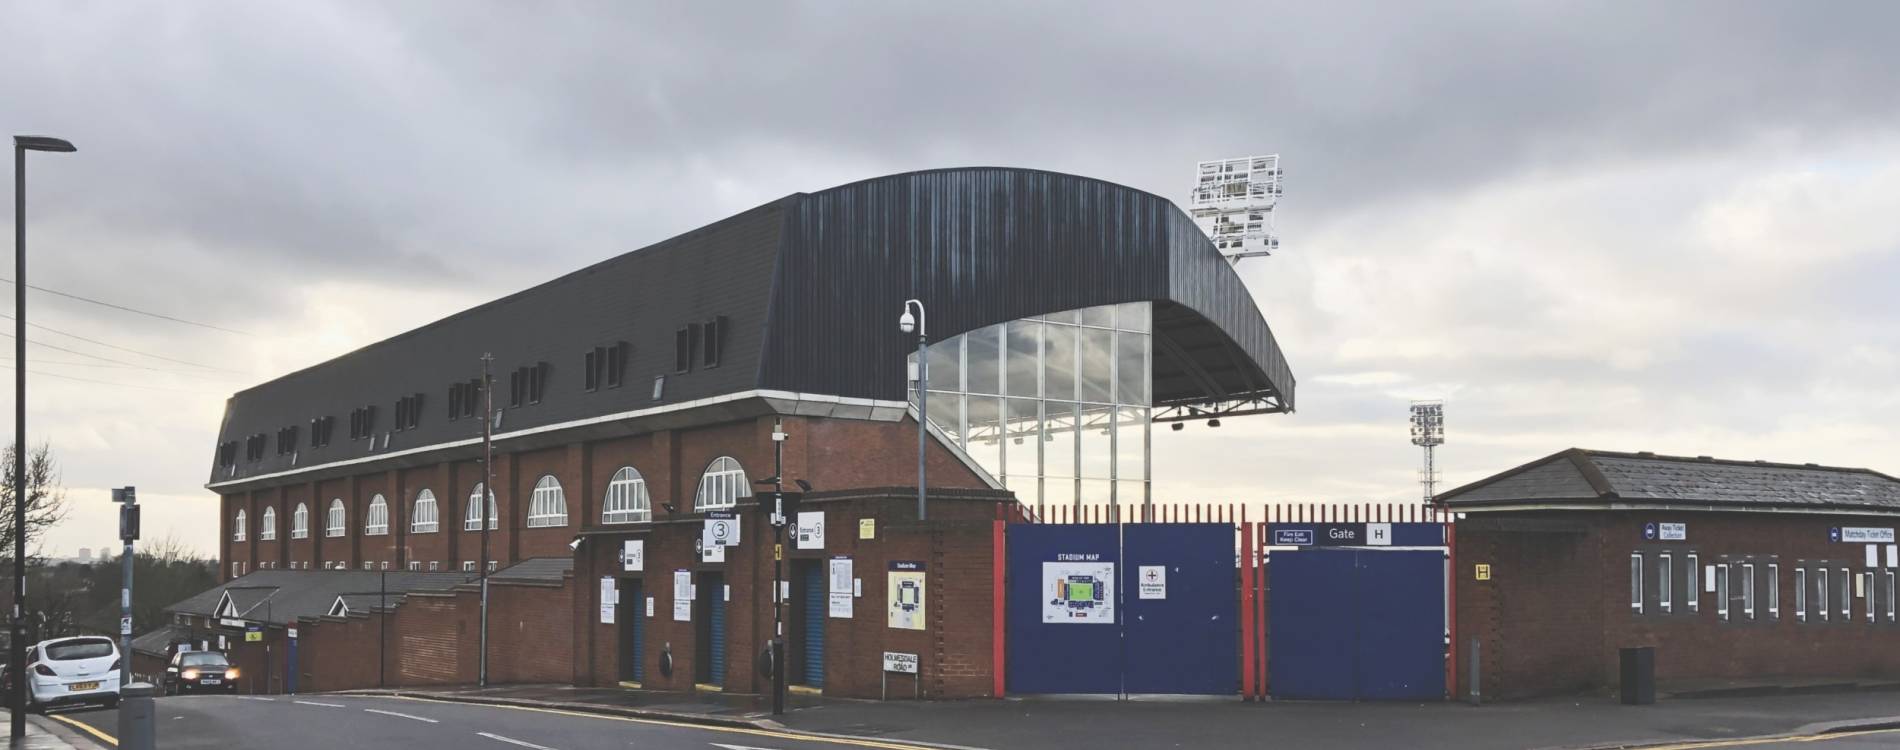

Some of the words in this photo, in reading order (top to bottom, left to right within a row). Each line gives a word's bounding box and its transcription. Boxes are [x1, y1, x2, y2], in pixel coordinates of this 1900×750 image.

[716, 523, 725, 537] 3
[1329, 528, 1355, 539] Gate
[1374, 529, 1384, 539] H
[1844, 529, 1866, 540] Matchday
[1866, 529, 1879, 538] Ticket
[1880, 529, 1893, 539] Office
[1057, 553, 1085, 561] STADIUM
[1086, 553, 1100, 561] MAP
[885, 653, 917, 664] HOLMESDALE
[893, 663, 907, 672] ROAD
